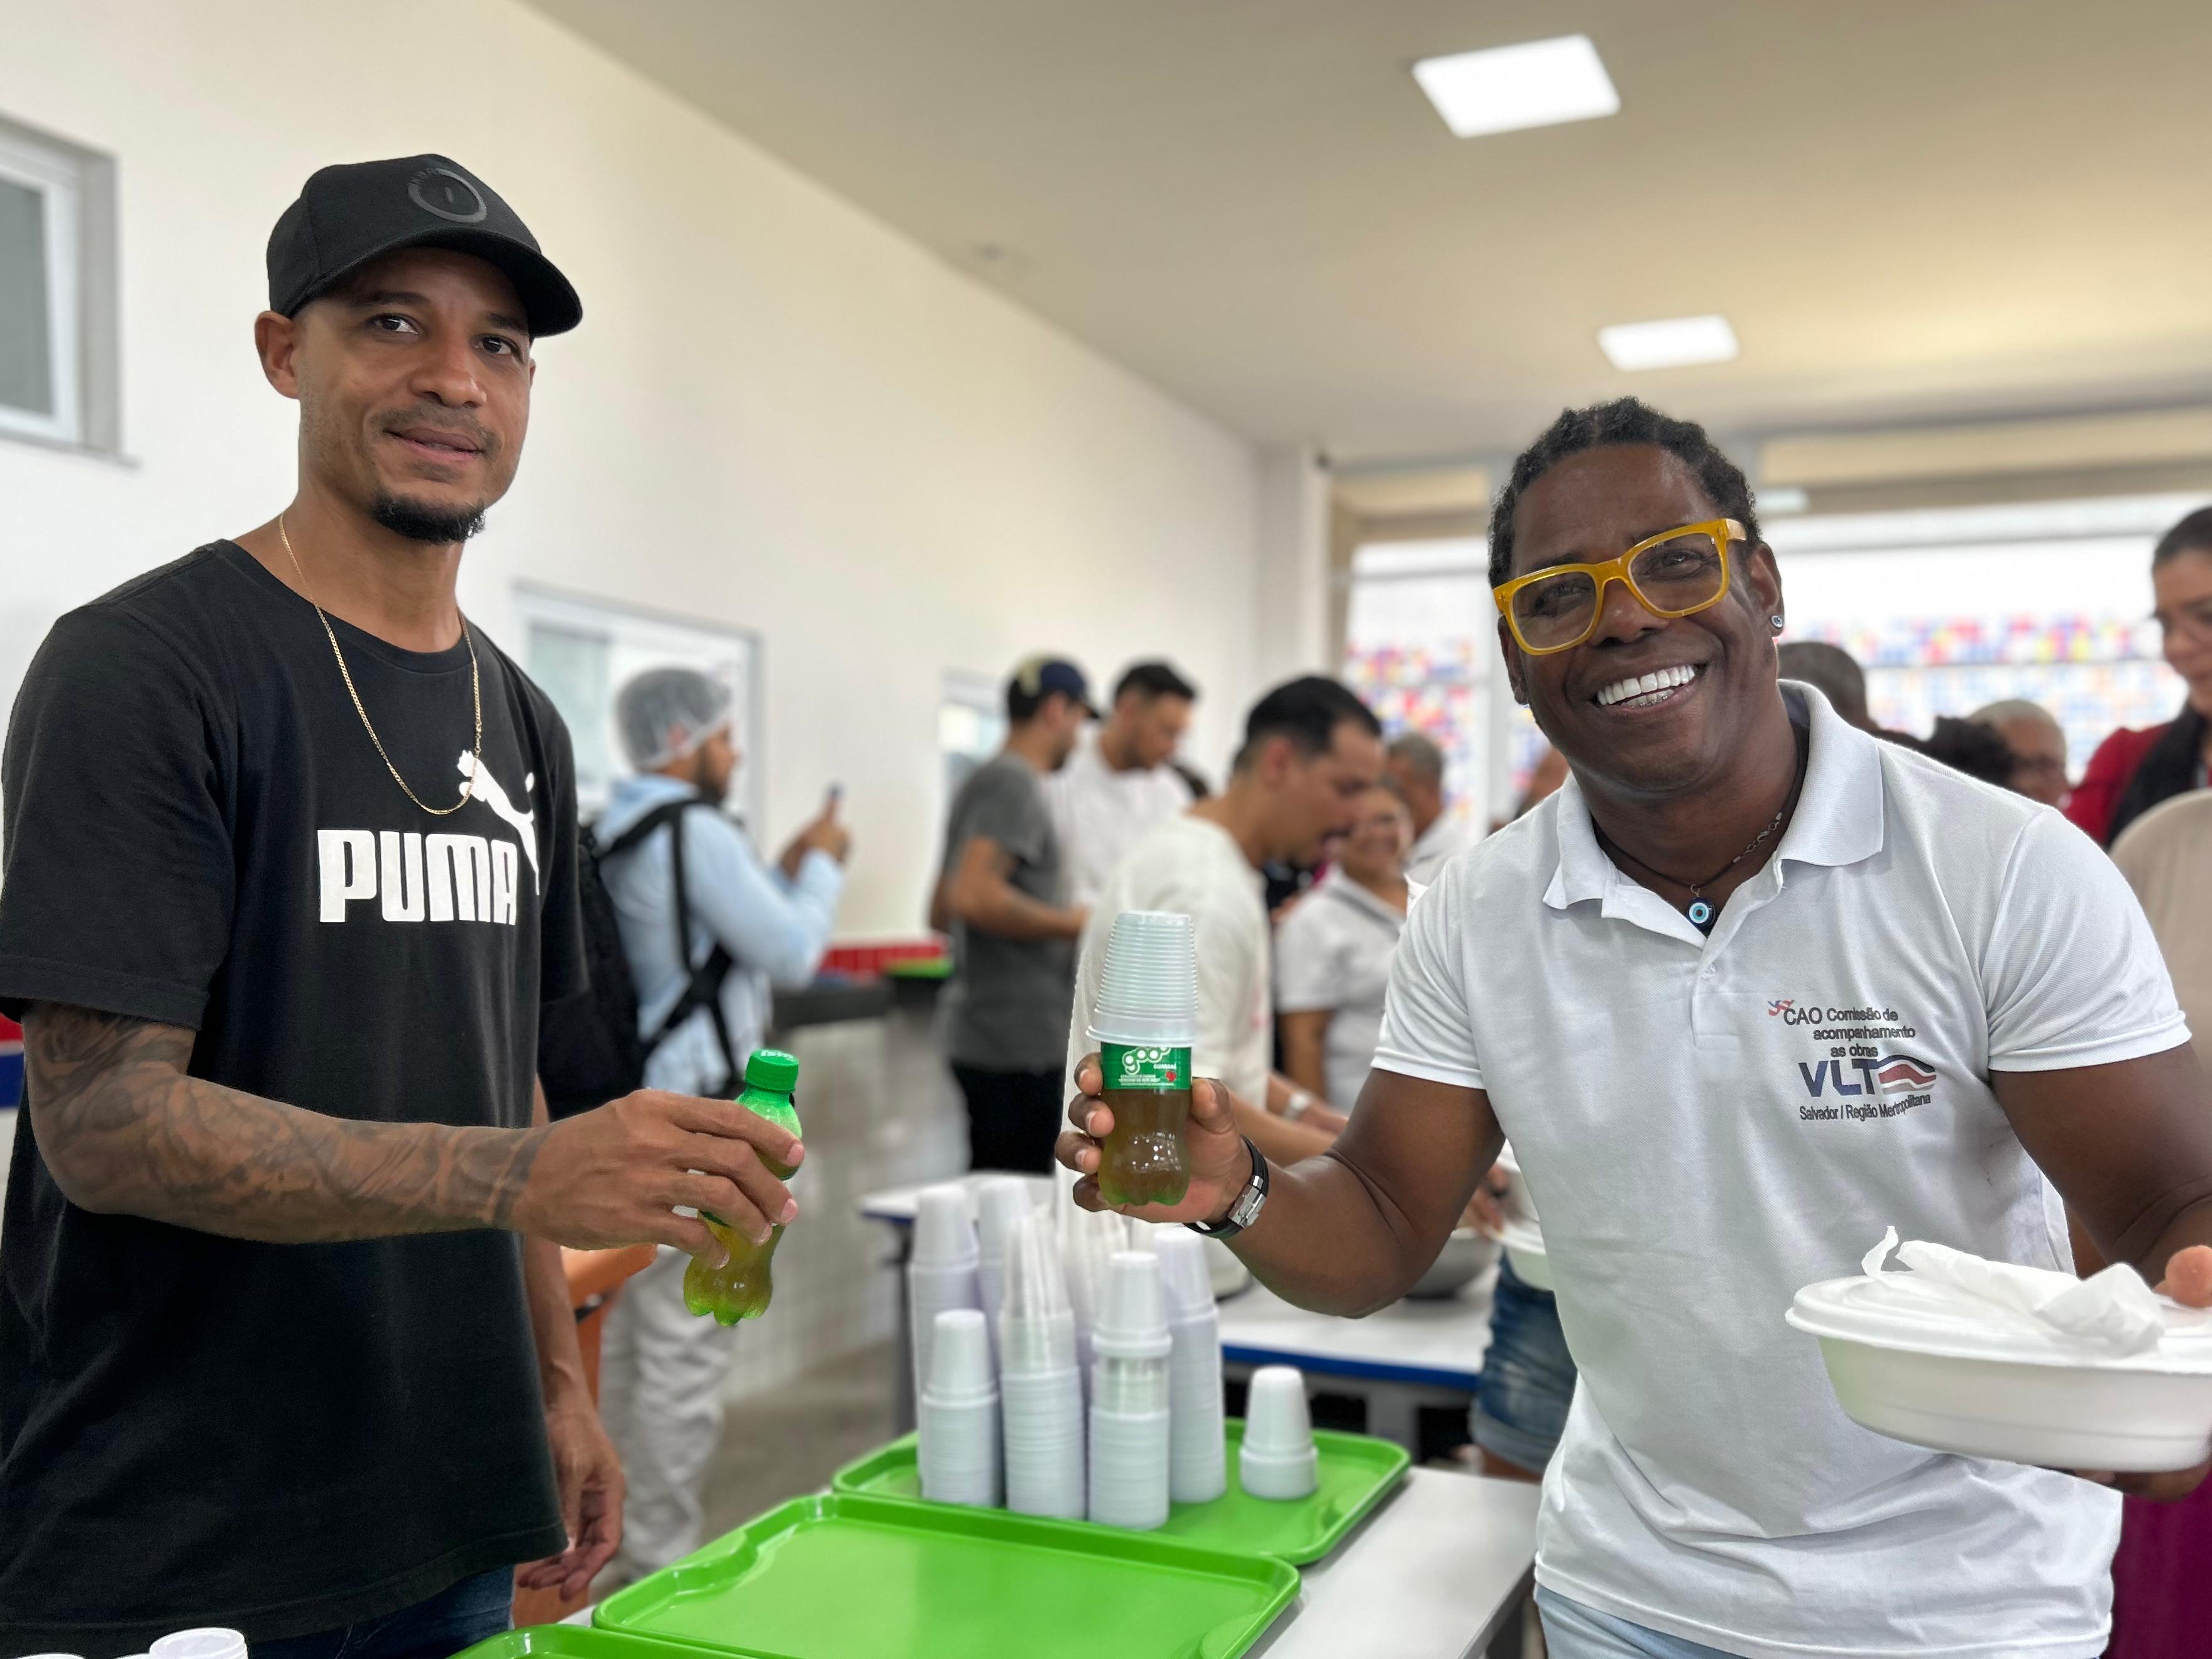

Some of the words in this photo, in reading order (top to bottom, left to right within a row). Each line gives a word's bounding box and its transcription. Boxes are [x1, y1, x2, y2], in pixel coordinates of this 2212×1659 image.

[317, 830, 518, 926] PUMA
[1783, 1007, 1822, 1025] CAO
[1826, 1007, 1881, 1022] Comissão
[1882, 1008, 1898, 1022] de
[1813, 1026, 1915, 1041] acompanhamento
[1830, 1046, 1846, 1058] as
[1849, 1043, 1878, 1058] obras
[1798, 1059, 1880, 1097] VLT
[1799, 1105, 1839, 1121] Salvador
[1846, 1104, 1878, 1122] Região
